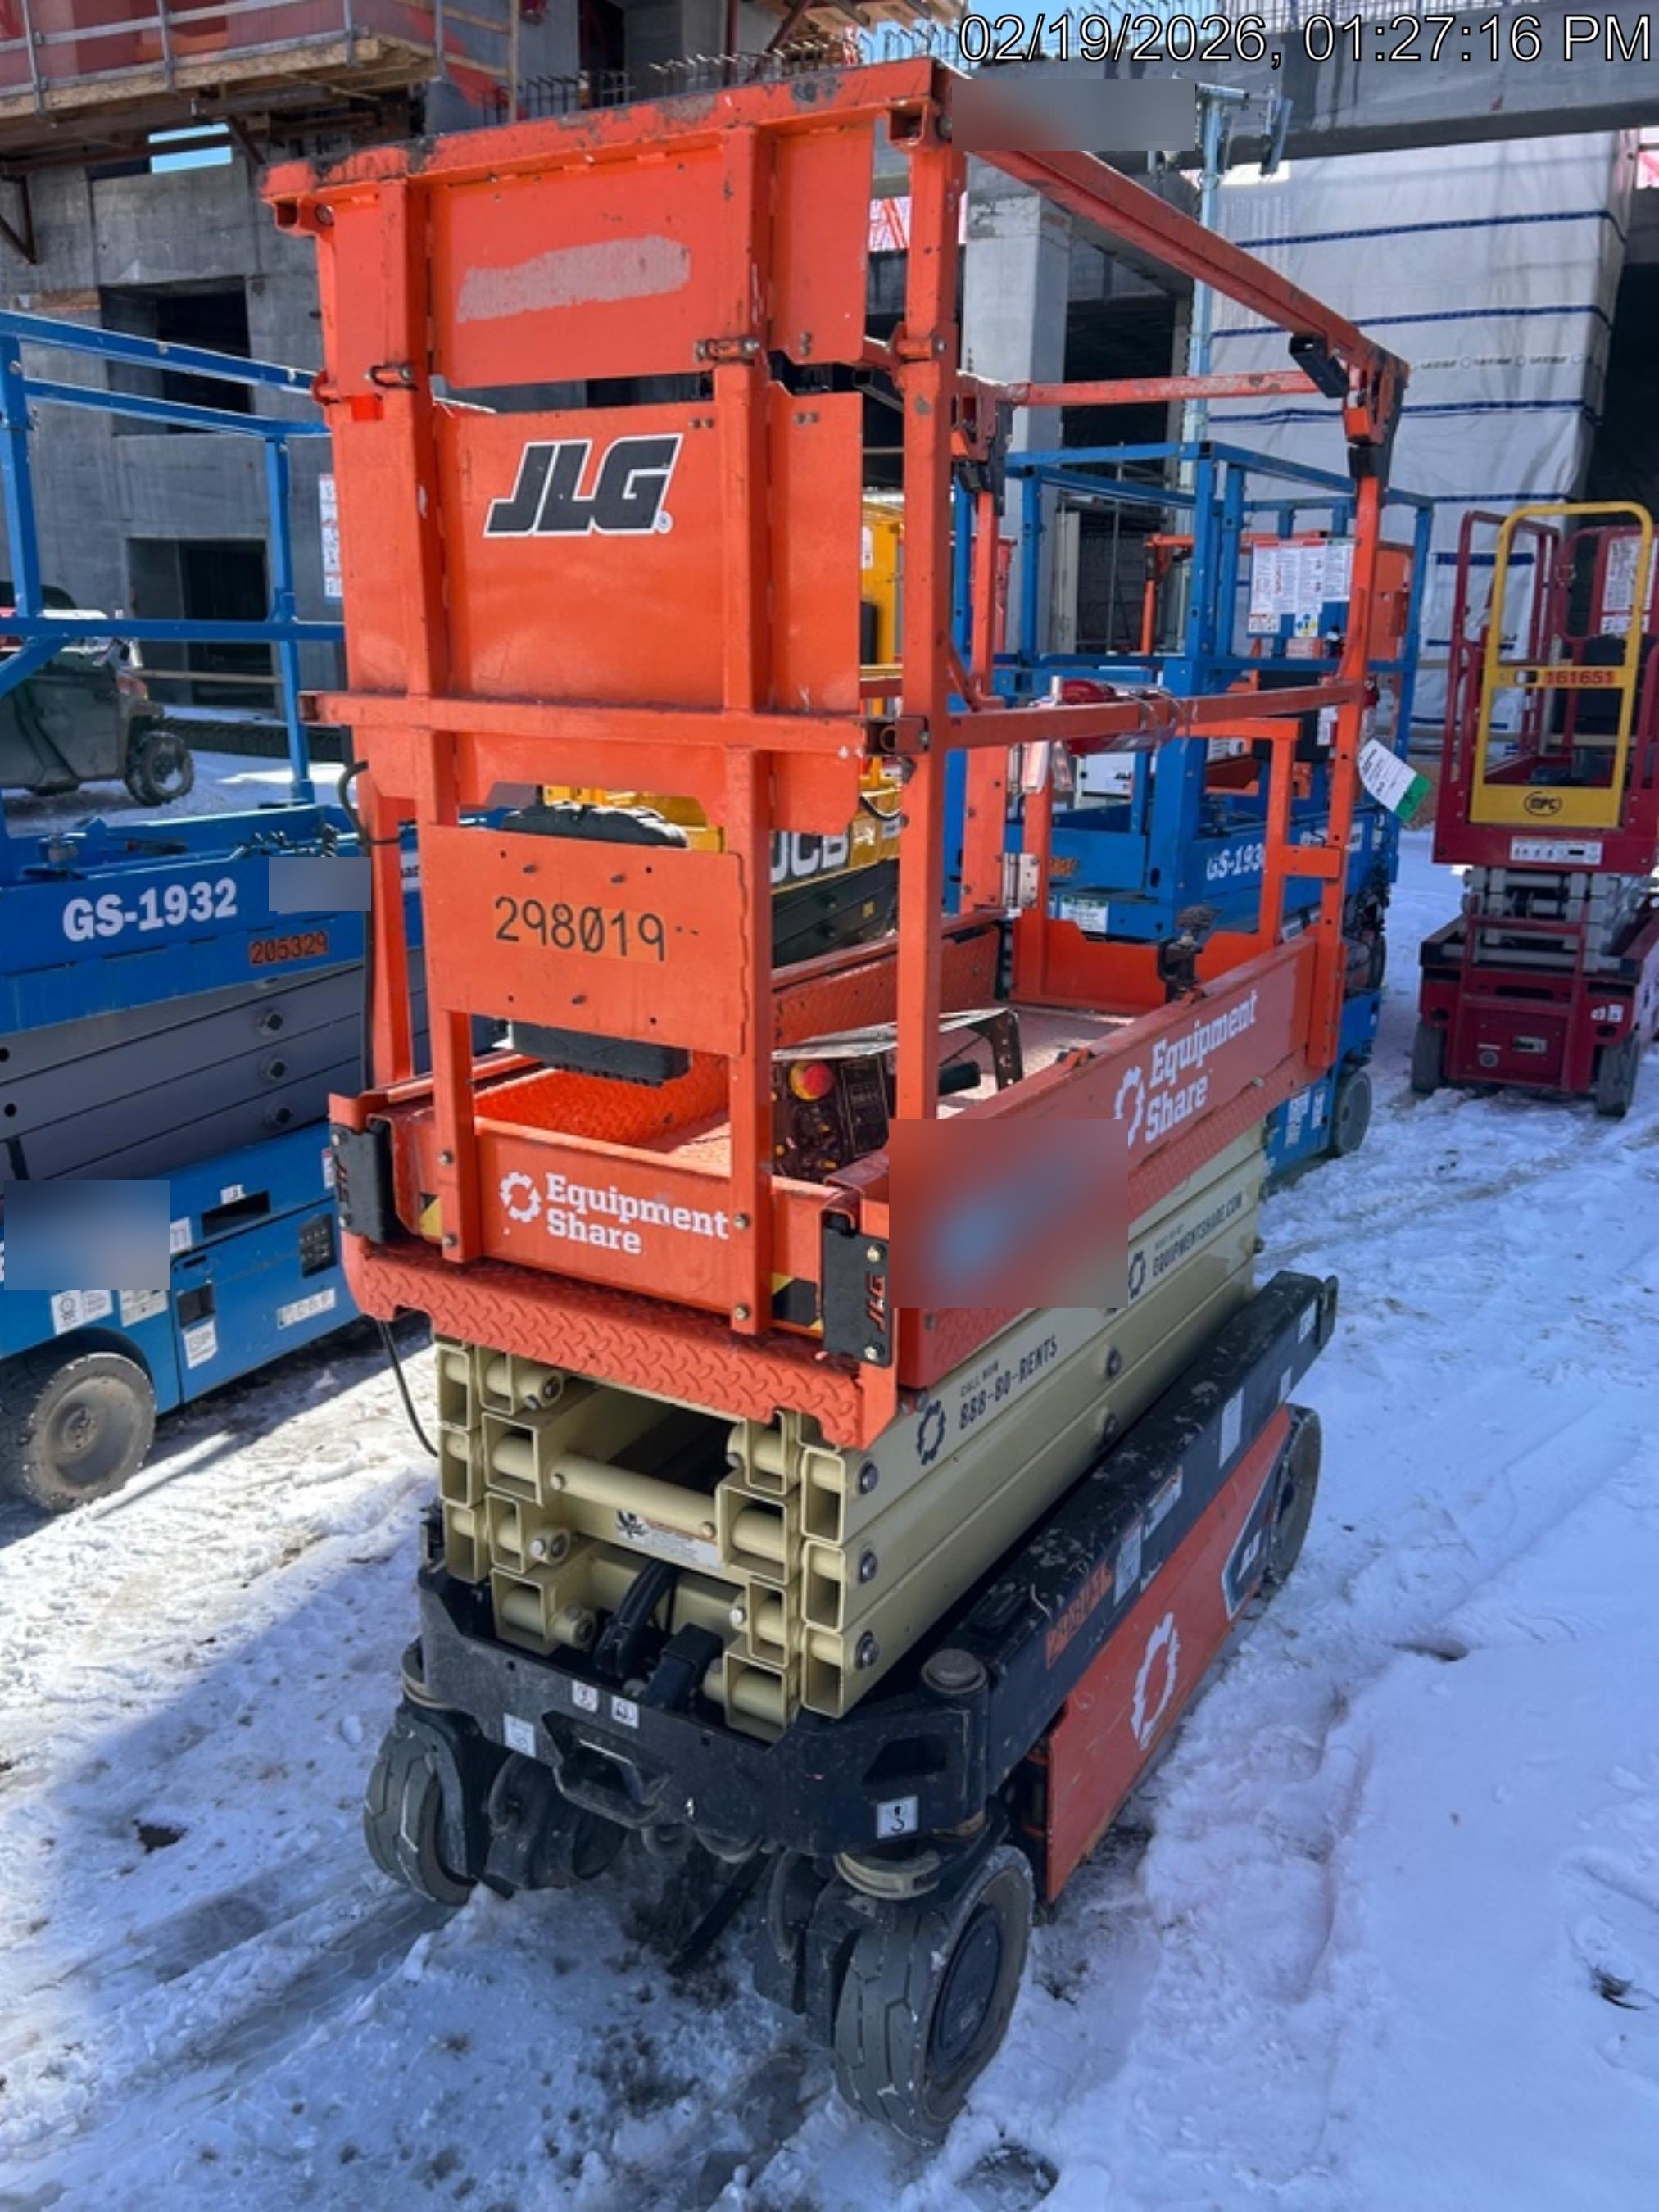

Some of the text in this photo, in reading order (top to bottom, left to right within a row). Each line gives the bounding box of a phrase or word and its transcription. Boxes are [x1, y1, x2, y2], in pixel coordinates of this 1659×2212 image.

[483, 433, 684, 538] JLG
[62, 877, 238, 942] GS-1932
[252, 931, 327, 964] 205329
[1149, 989, 1259, 1090] Equipment
[1145, 1076, 1208, 1144] Share
[545, 1172, 730, 1240] Equipment
[546, 1207, 643, 1255] Share
[959, 1333, 1058, 1430] 888-80-RENTS
